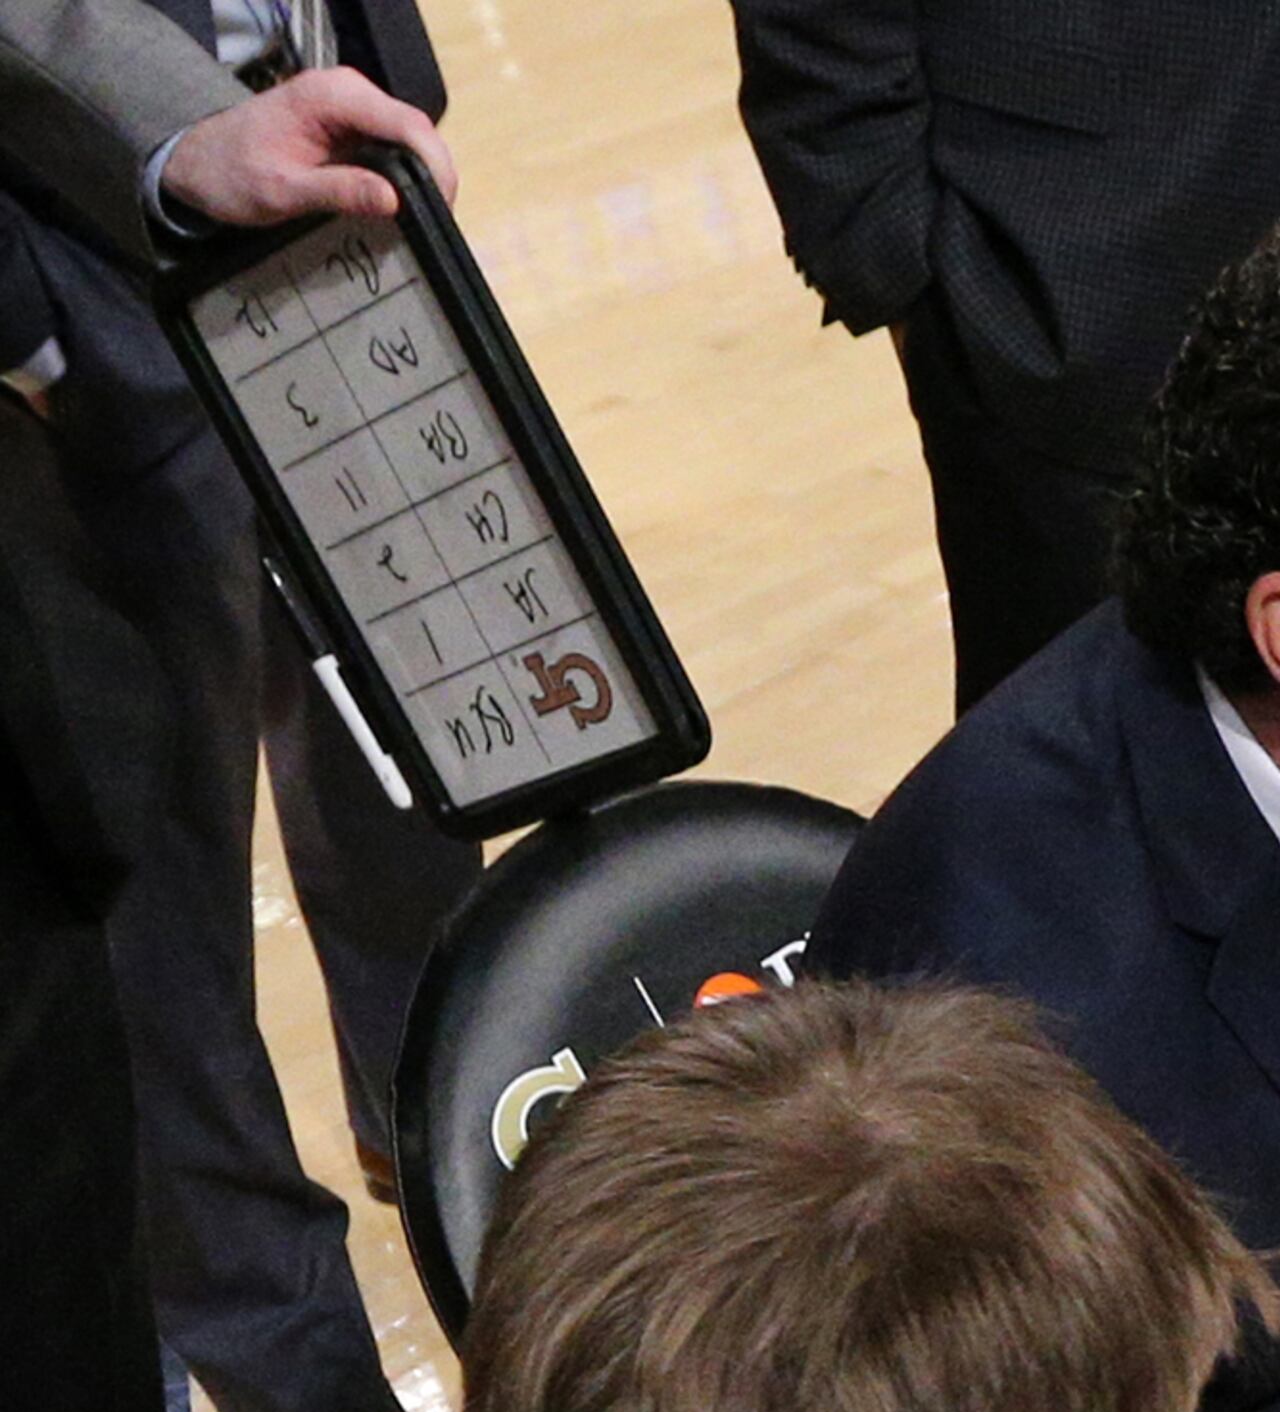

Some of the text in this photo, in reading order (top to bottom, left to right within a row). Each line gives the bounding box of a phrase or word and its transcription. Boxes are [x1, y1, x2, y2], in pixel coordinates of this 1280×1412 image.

[236, 298, 279, 338] 12
[286, 327, 418, 428] AD 3
[334, 410, 468, 512] BA 11
[377, 490, 509, 582] CH 2
[503, 567, 549, 623] JA
